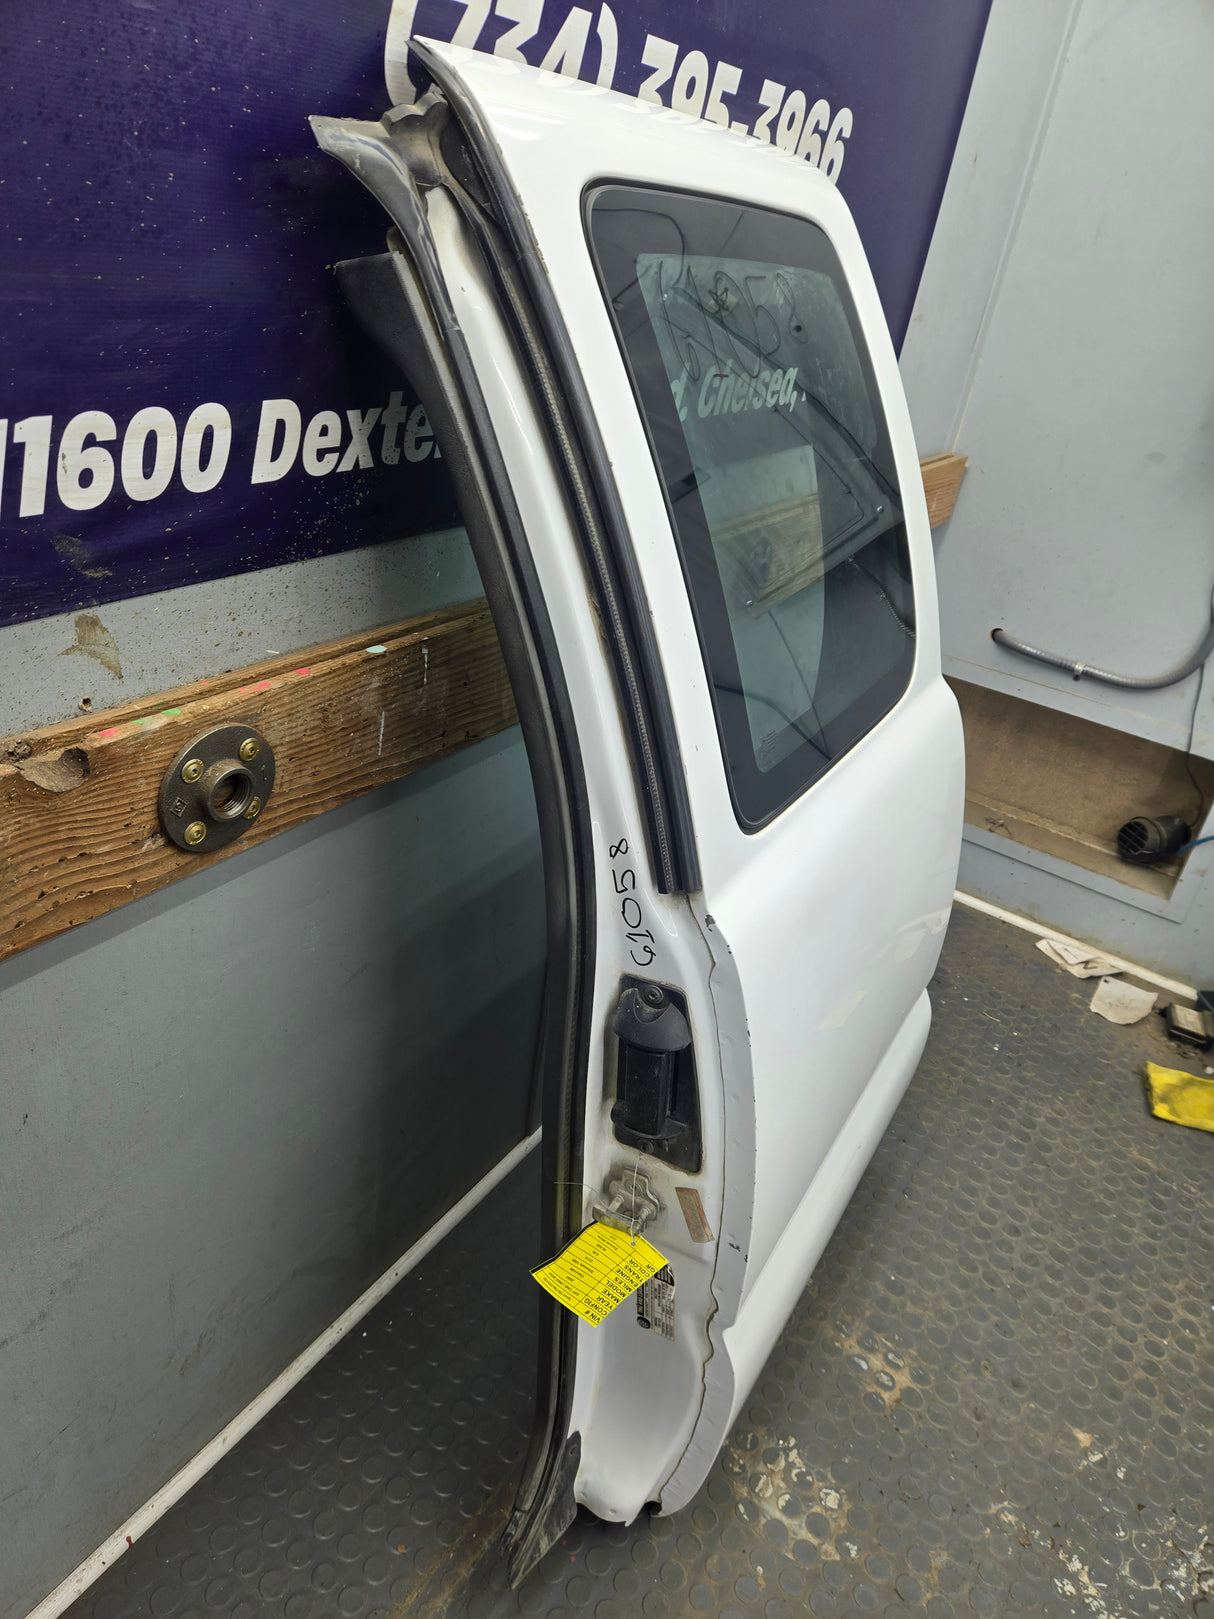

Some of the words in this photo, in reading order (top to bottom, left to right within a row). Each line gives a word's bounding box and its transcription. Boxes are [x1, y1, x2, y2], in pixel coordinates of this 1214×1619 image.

[0, 402, 232, 520] 1600
[251, 390, 442, 484] Dexte
[623, 1263, 643, 1282] TRANS
[628, 1258, 650, 1277] COLOR
[645, 1263, 655, 1273] GR
[613, 1276, 632, 1292] MILES
[614, 1267, 638, 1287] ENGINE
[601, 1287, 620, 1303] MAKE
[604, 1279, 626, 1297] MODEL
[583, 1297, 607, 1315] CONFIG
[596, 1295, 614, 1309] YEAR
[589, 1312, 601, 1323] VIN
